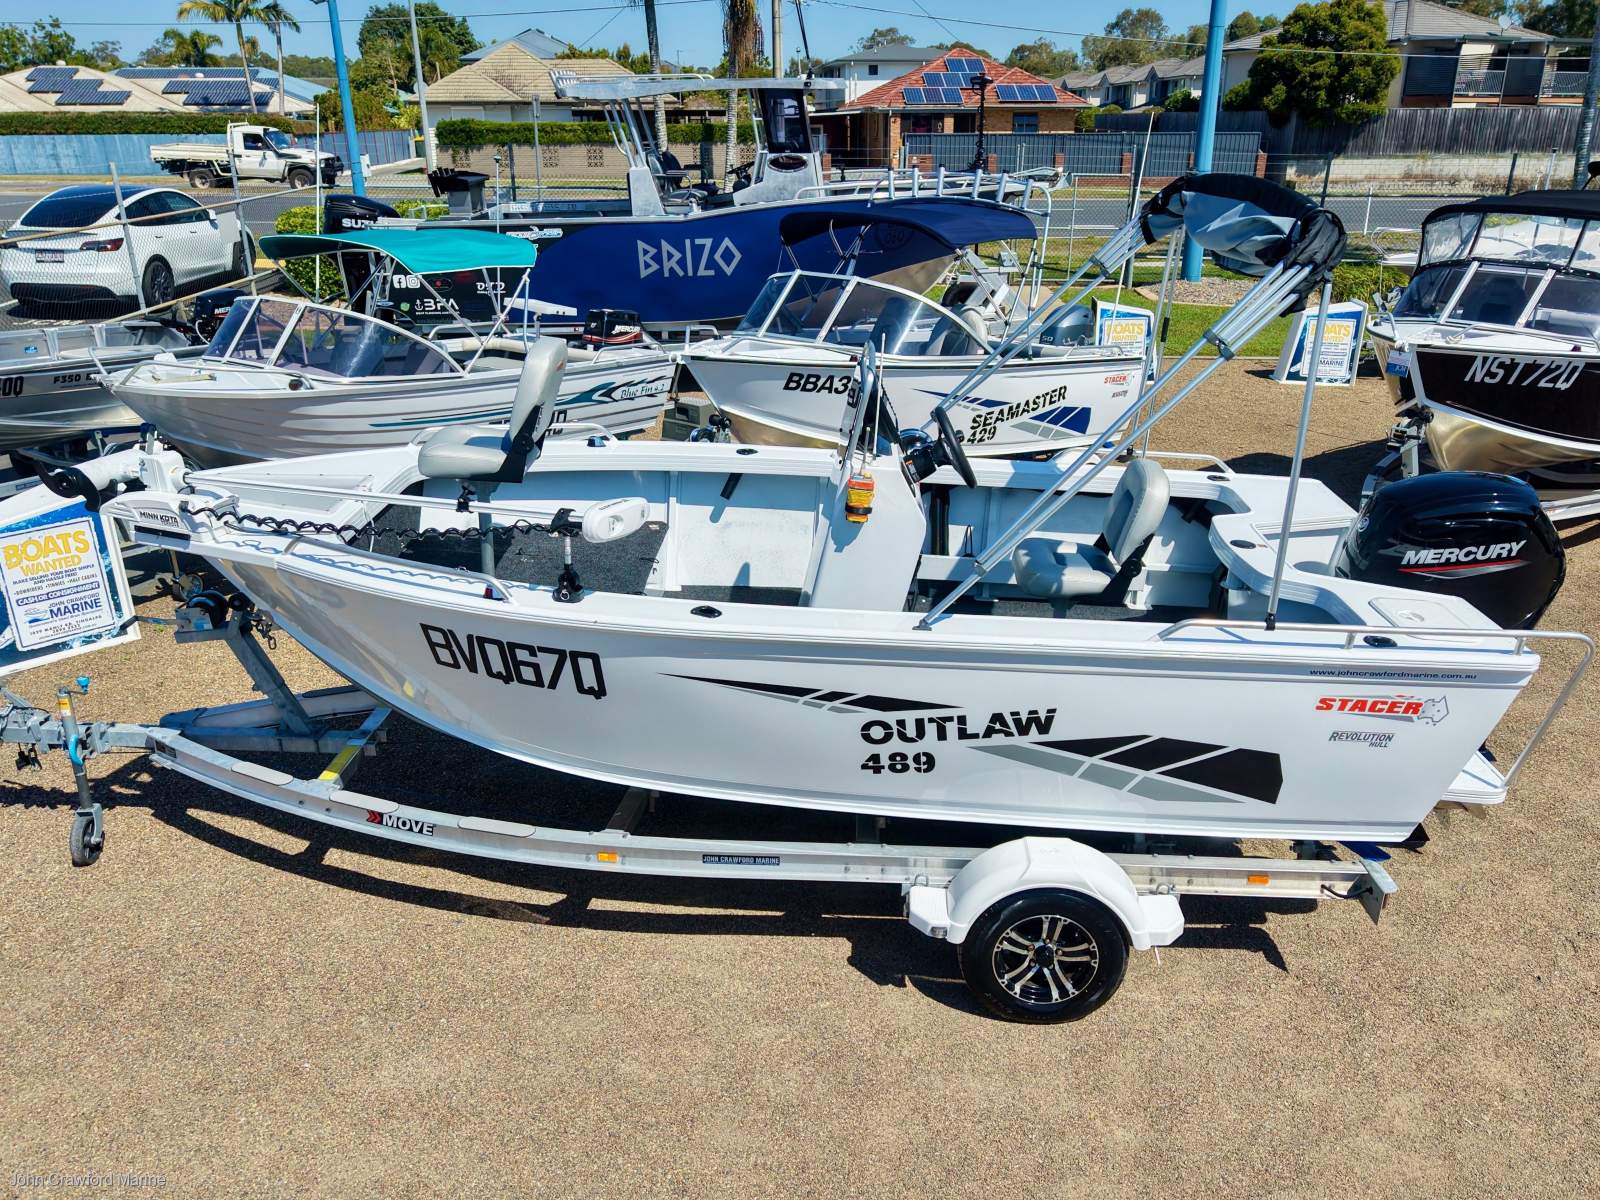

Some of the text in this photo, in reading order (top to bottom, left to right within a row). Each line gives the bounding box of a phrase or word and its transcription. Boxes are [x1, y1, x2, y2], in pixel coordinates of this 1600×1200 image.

[637, 237, 742, 279] BRIZO
[1464, 355, 1586, 391] NST72Q
[970, 384, 1068, 430] SEAMASTER
[968, 426, 997, 444] 429
[140, 511, 159, 520] MINN
[160, 514, 178, 525] KOTA
[4, 530, 90, 569] BOATS
[1401, 540, 1527, 565] MERCURY
[20, 554, 82, 577] WANTED
[48, 592, 100, 609] JOHN CRAWFORD
[49, 597, 101, 619] MARINE
[419, 623, 607, 700] BVQ67Q
[1309, 669, 1477, 679] www.johncrawfordmarine.com.au
[1315, 697, 1424, 715] STACER
[860, 708, 1057, 745] OUTLAW
[860, 752, 936, 775] 489
[383, 814, 433, 836] MOVE
